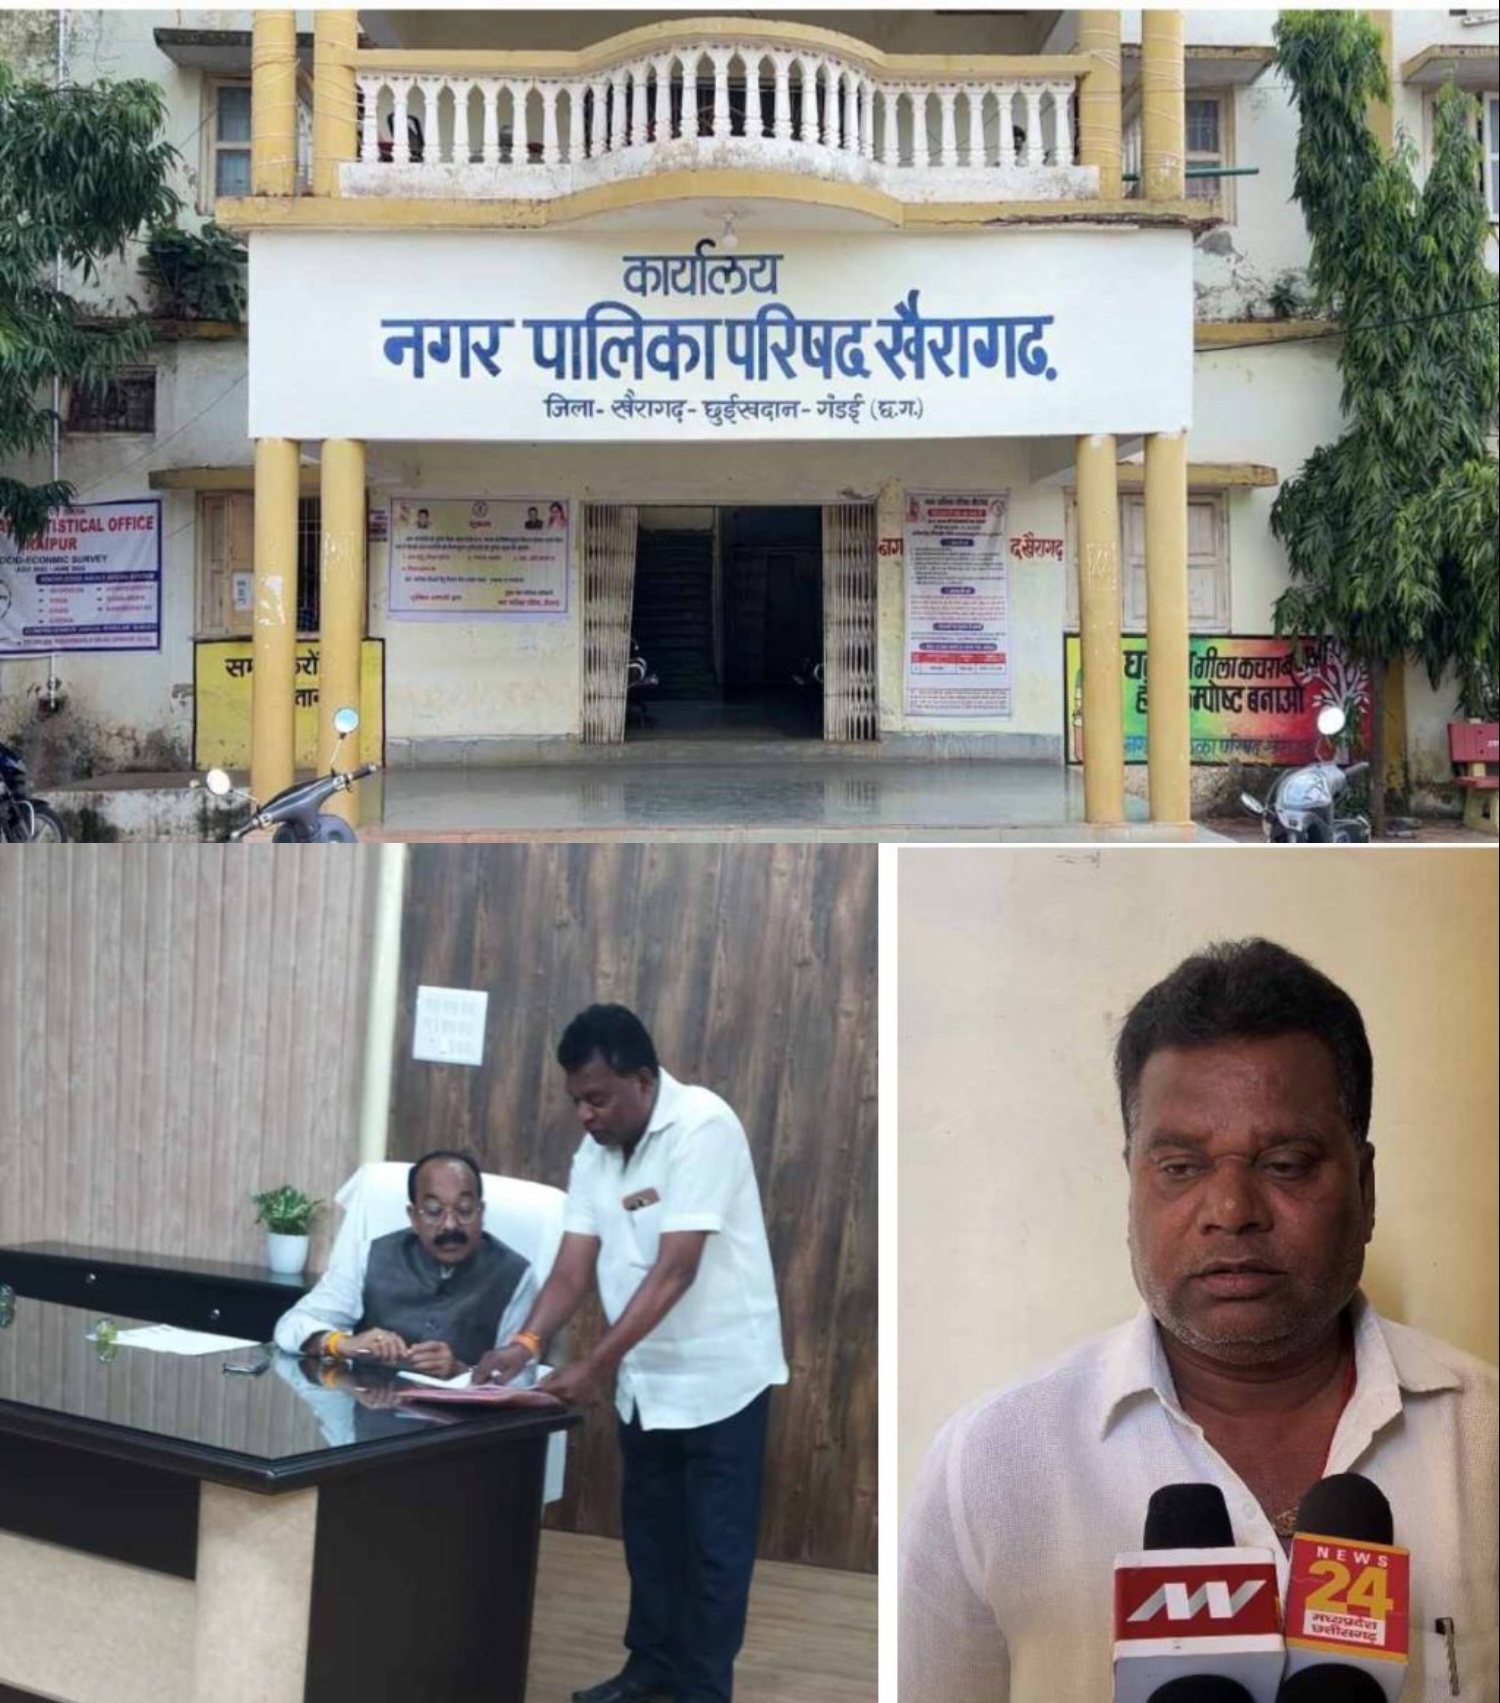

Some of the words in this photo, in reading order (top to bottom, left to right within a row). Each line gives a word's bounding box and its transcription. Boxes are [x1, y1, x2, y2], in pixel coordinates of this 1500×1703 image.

[622, 238, 784, 297] कार्यालय
[381, 318, 514, 378] नगर
[522, 301, 721, 381] पालिका
[725, 302, 871, 381] परिषद
[107, 516, 154, 532] OFFICE
[1316, 1545, 1389, 1569] NEWS
[1305, 1559, 1395, 1621] 24
